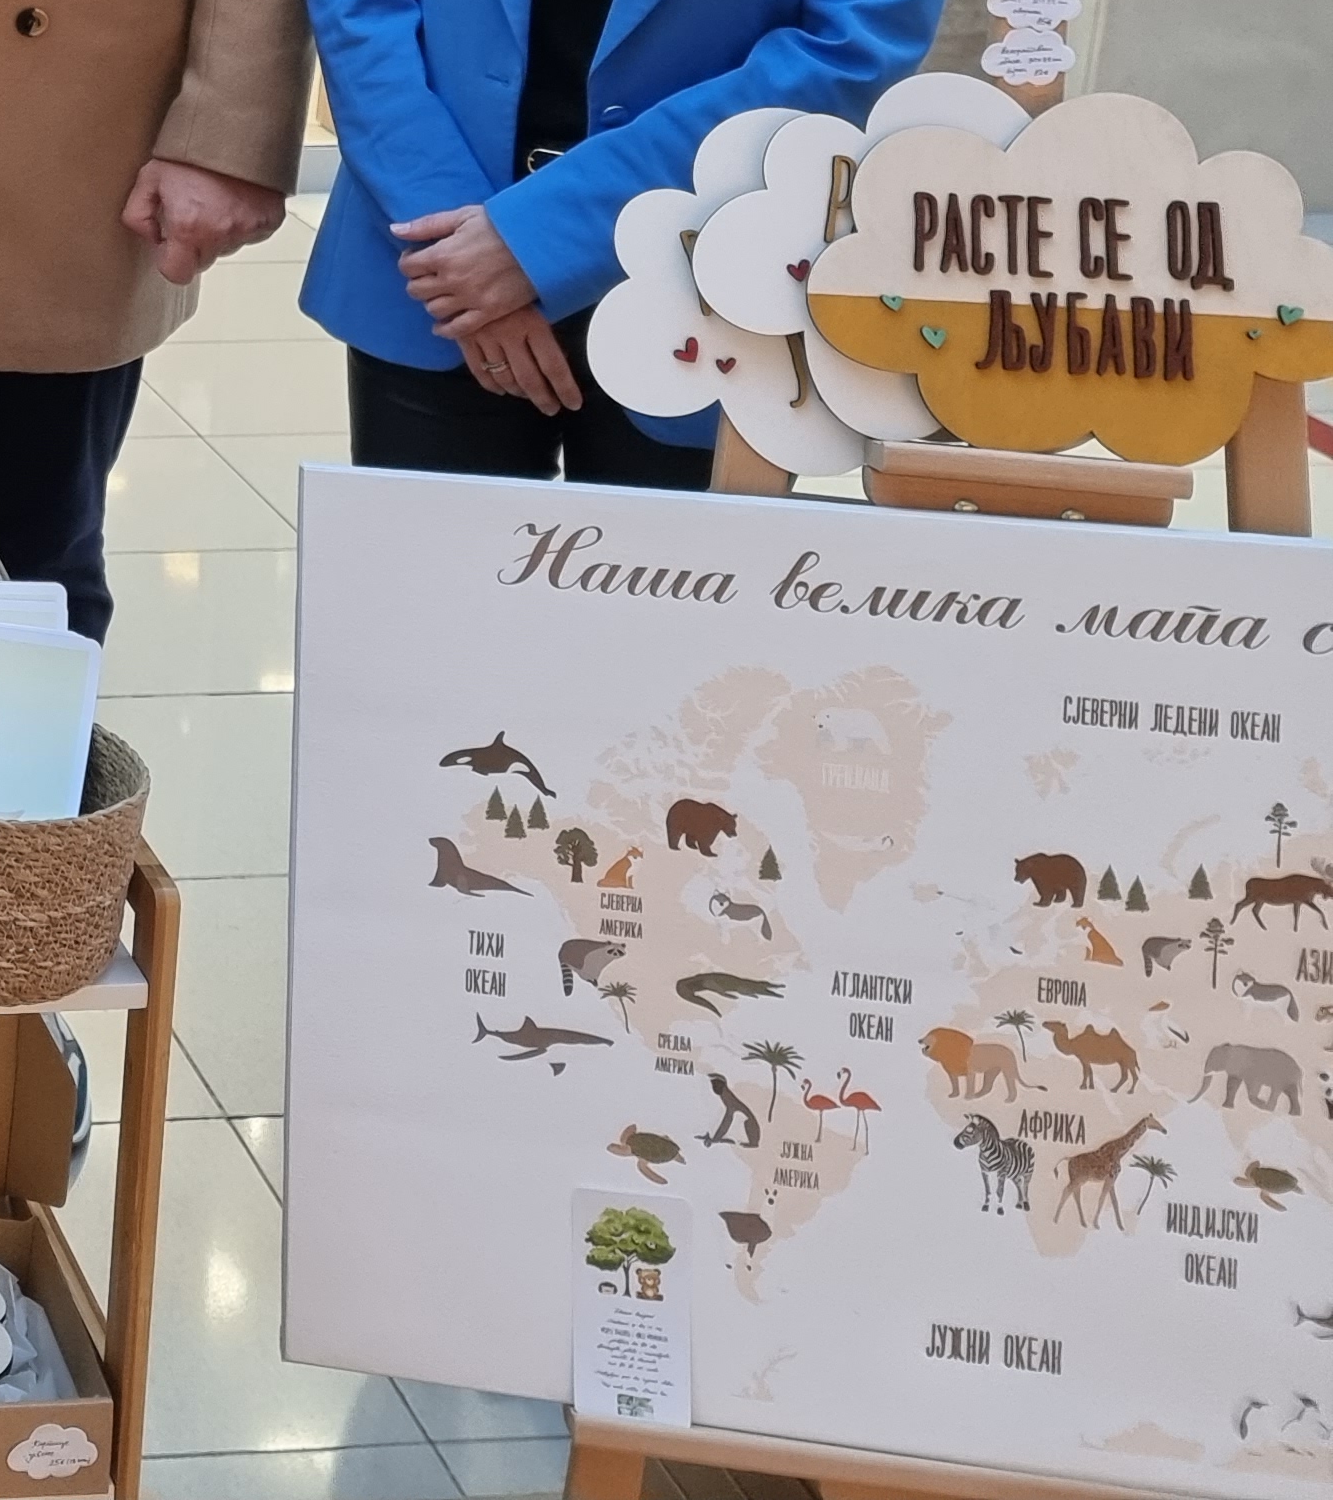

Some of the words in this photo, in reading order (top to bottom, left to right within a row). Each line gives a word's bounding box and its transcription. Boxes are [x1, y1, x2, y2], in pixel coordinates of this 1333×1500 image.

[913, 191, 1054, 278] РАСТЕ
[1079, 197, 1134, 281] СЕ
[1166, 200, 1235, 292] ОД
[975, 289, 1194, 381] ЉУБАВИ
[497, 522, 739, 604] Наша
[769, 550, 1026, 630] велика
[1062, 695, 1140, 731] СЈЕВЕРНИ
[1150, 702, 1220, 738] ЛЕДЕНИ
[1230, 709, 1283, 744] ОКЕАН
[600, 892, 643, 914] СЈЕВЕРНА
[468, 929, 504, 958] ТИХИ
[599, 918, 643, 939] АМЕРИКА
[465, 968, 506, 997] ОКЕАН
[1295, 947, 1333, 985] АЗИ
[831, 970, 912, 1004] АТЛАНТСКИ
[1037, 976, 1087, 1007] ЕВРОПА
[849, 1012, 894, 1042] ОКЕАН
[654, 1056, 694, 1076] АМЕРИКА
[1017, 1108, 1086, 1145] АФРИКА
[780, 1141, 813, 1162] ЈУЖНА
[773, 1167, 820, 1189] АМЕРИКА
[1166, 1202, 1259, 1244] ИНДИЈСКИ
[1184, 1253, 1238, 1289] ОКЕАН
[926, 1323, 991, 1366] ЈУЖНИ
[1003, 1334, 1063, 1376] ОКЕАН
